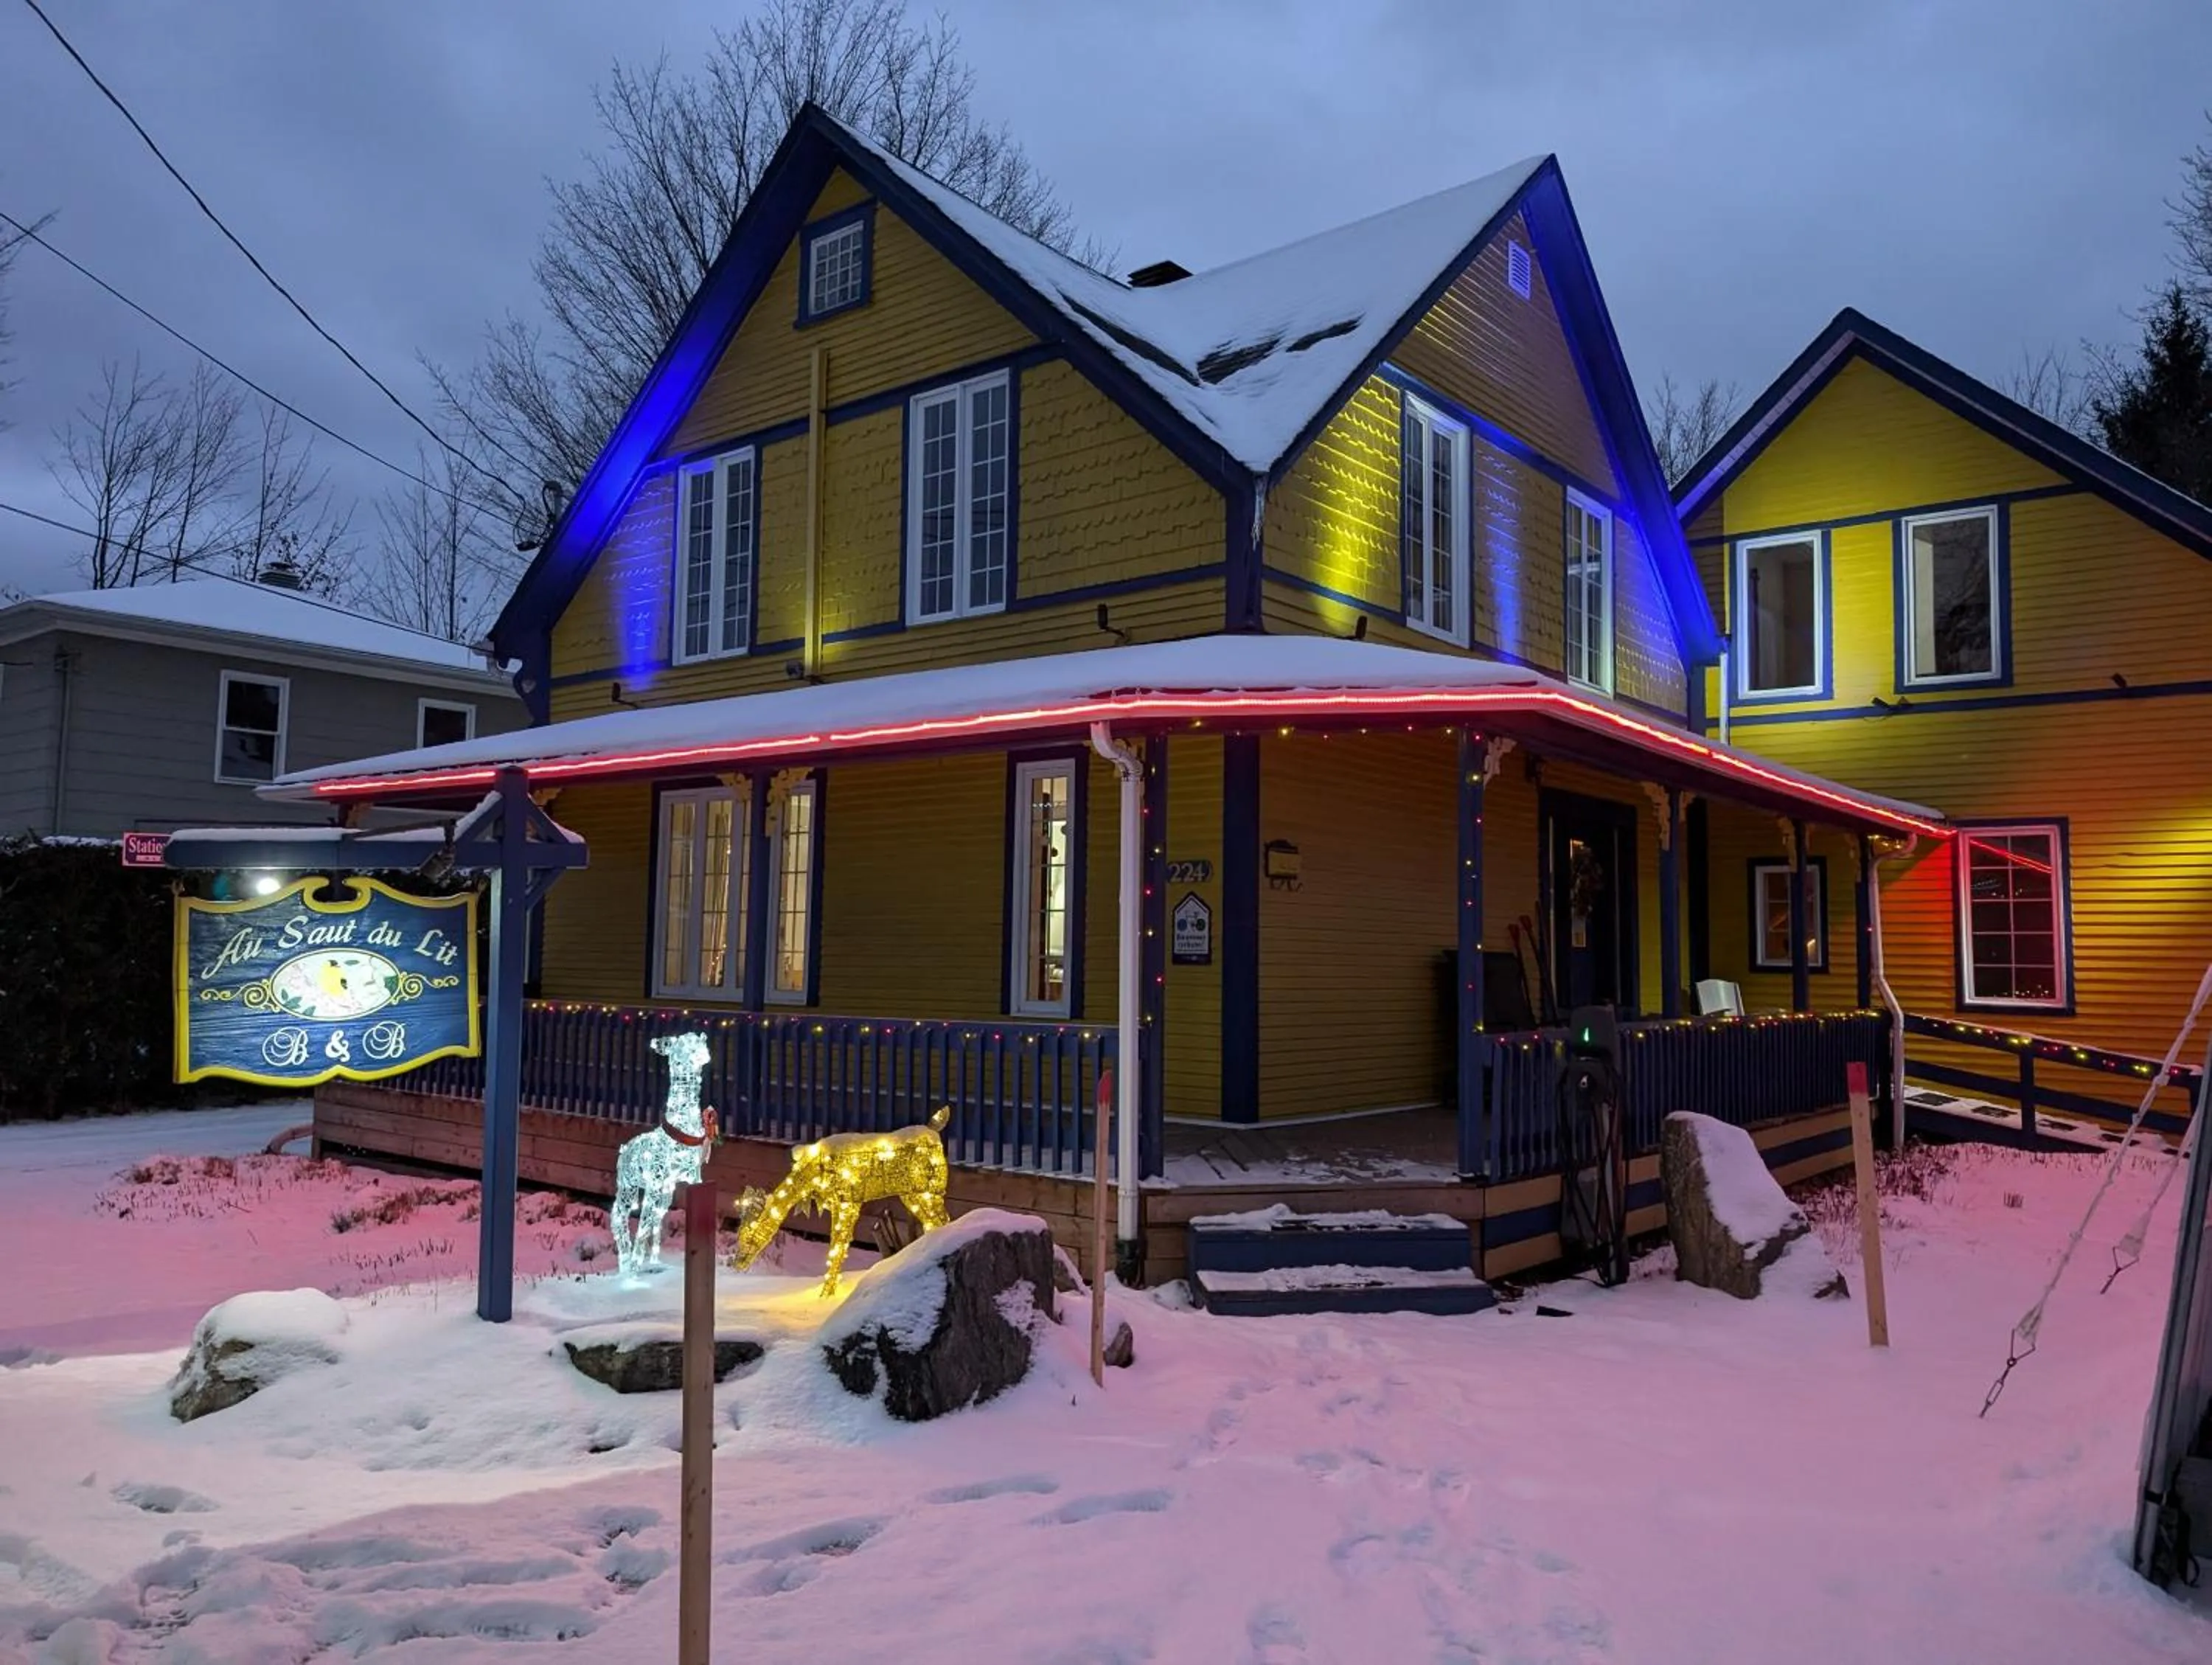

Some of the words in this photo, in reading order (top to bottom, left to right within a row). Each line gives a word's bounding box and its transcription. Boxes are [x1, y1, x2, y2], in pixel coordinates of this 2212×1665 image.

[1169, 861, 1206, 882] 224
[201, 927, 262, 980] Au
[278, 916, 357, 949] Saut
[368, 920, 402, 948] du
[414, 929, 459, 965] Lit
[262, 1027, 308, 1066] B
[324, 1029, 350, 1062] &
[362, 1021, 406, 1059] B
